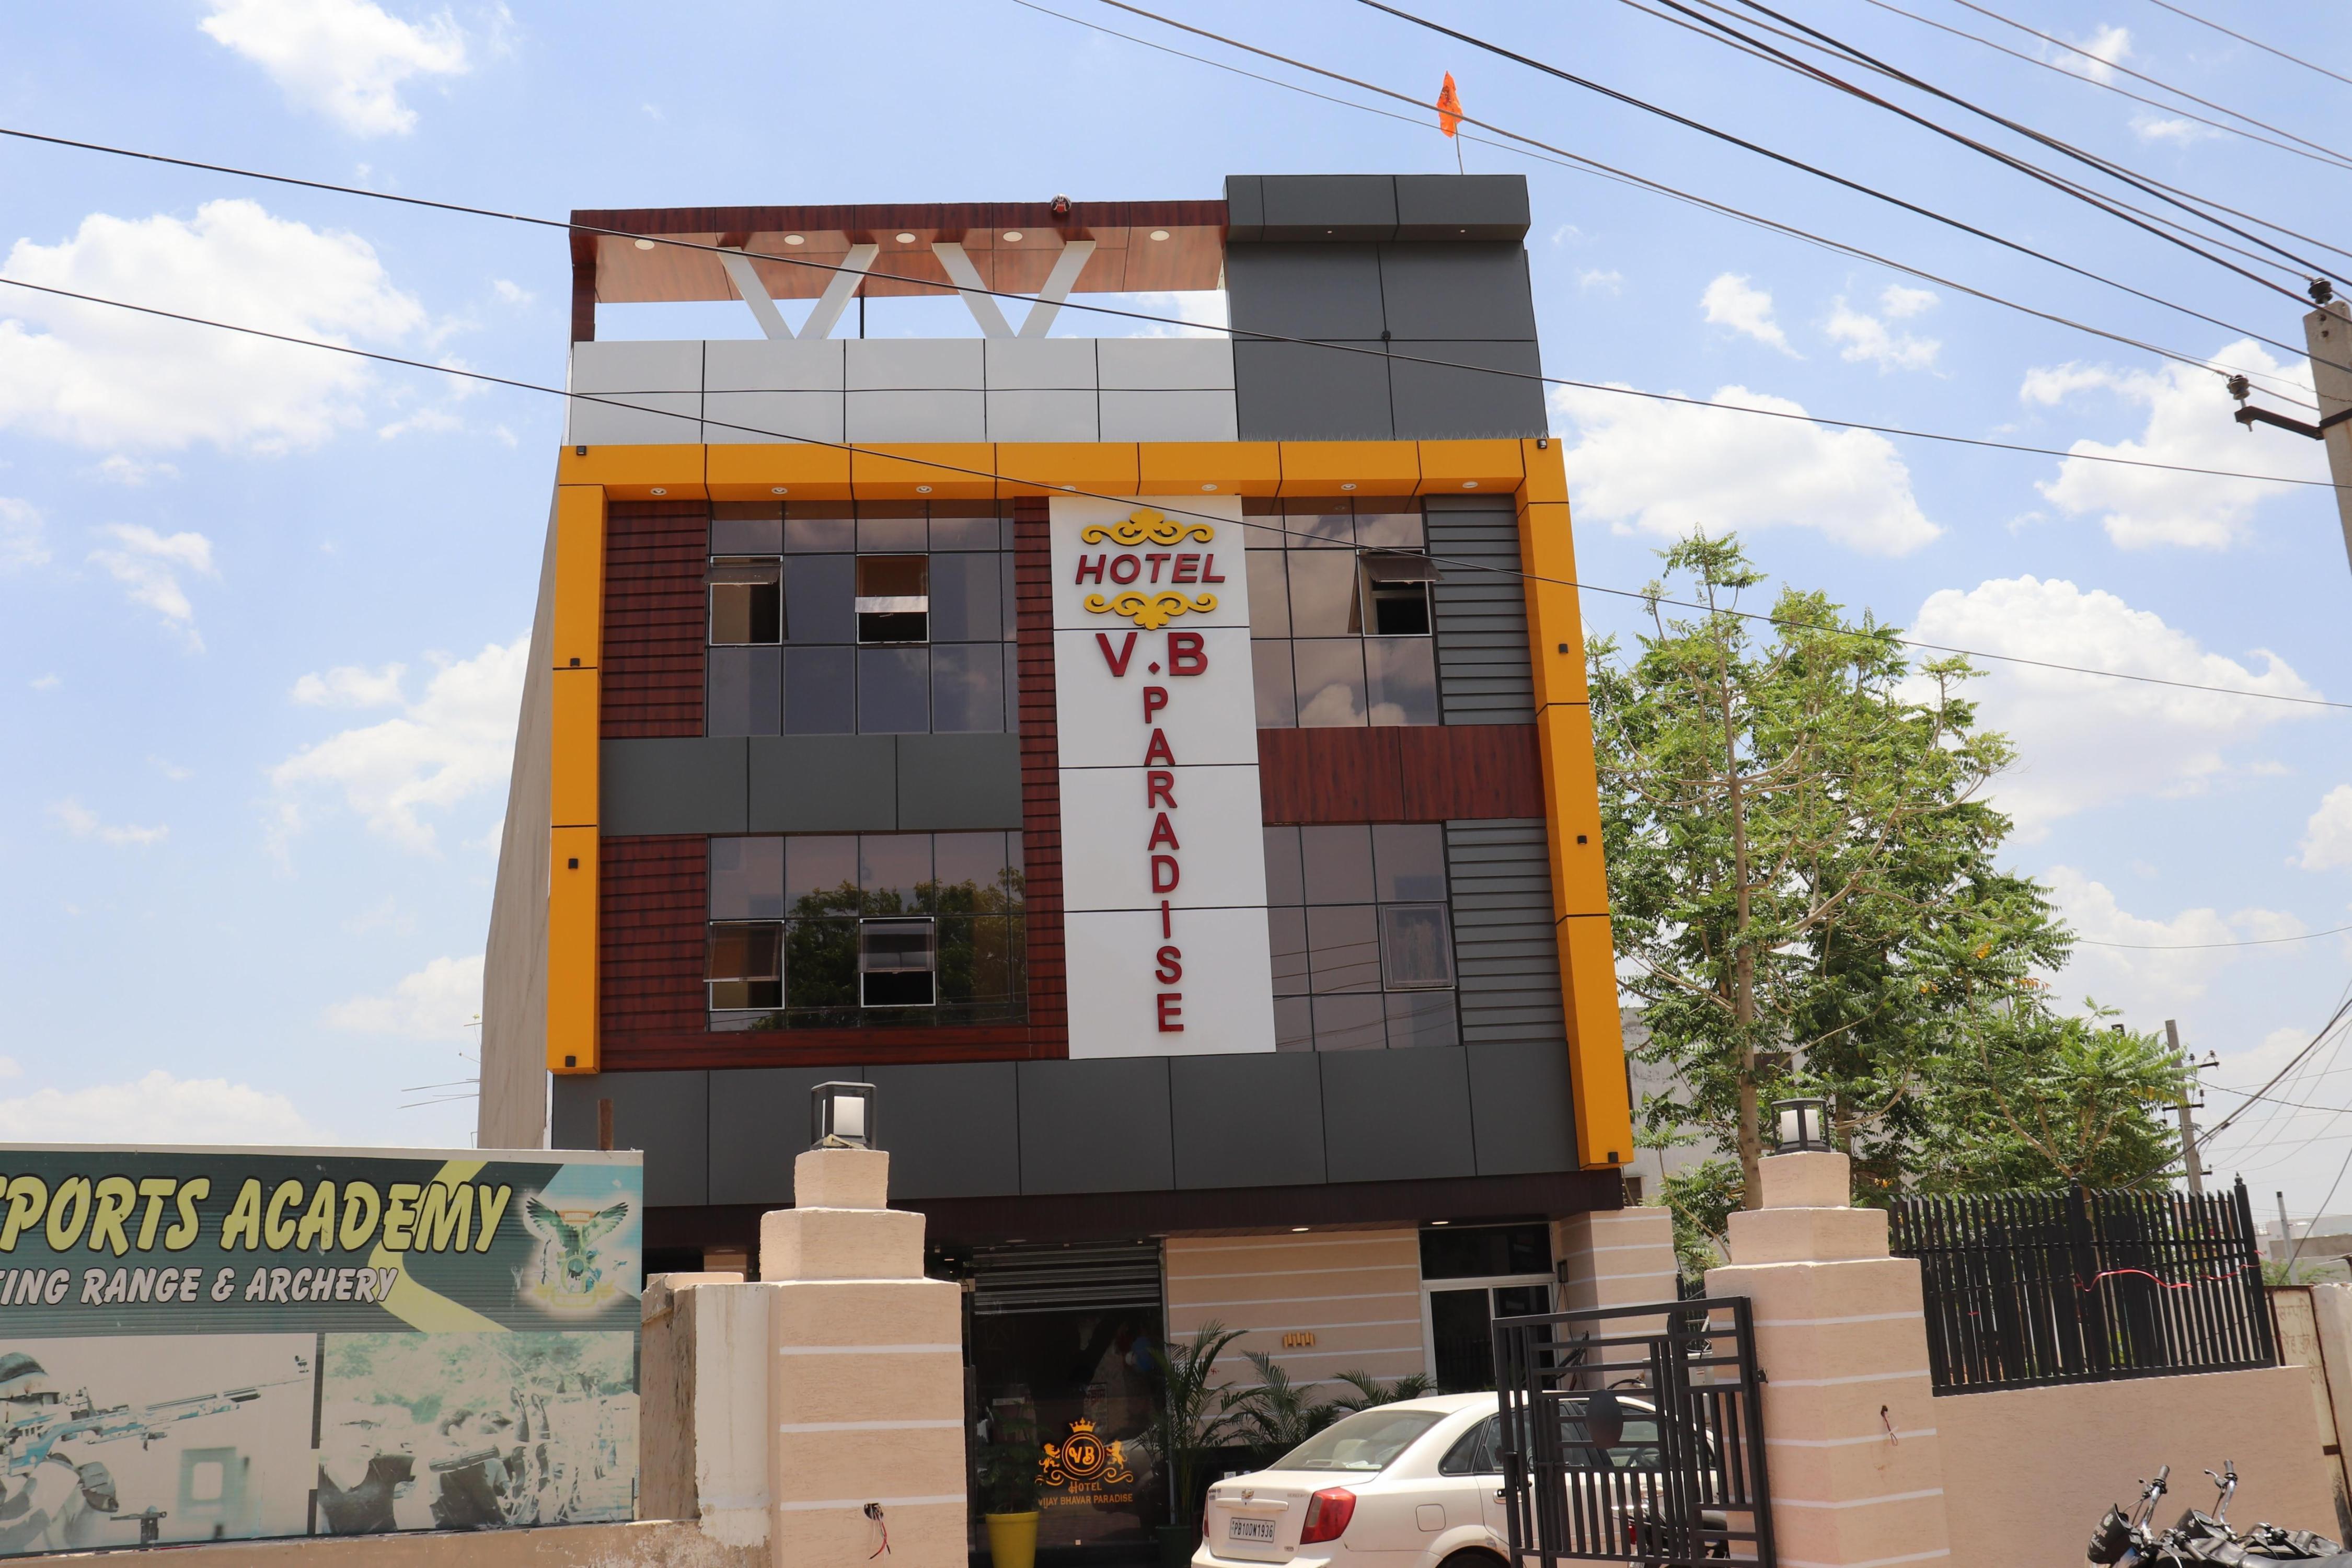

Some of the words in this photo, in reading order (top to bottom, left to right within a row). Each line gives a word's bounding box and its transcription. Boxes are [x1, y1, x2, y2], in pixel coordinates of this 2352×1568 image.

[1075, 554, 1226, 584] HOTEL
[1143, 686, 1184, 1032] PARADISE
[0, 1174, 211, 1259] PORTS
[220, 1176, 513, 1254] ACADEMY
[79, 1266, 204, 1306] RANGE
[210, 1266, 236, 1302] &
[244, 1266, 399, 1304] ARCHERY
[1068, 1446, 1095, 1466] VB
[1093, 1494, 1133, 1503] PARADISE
